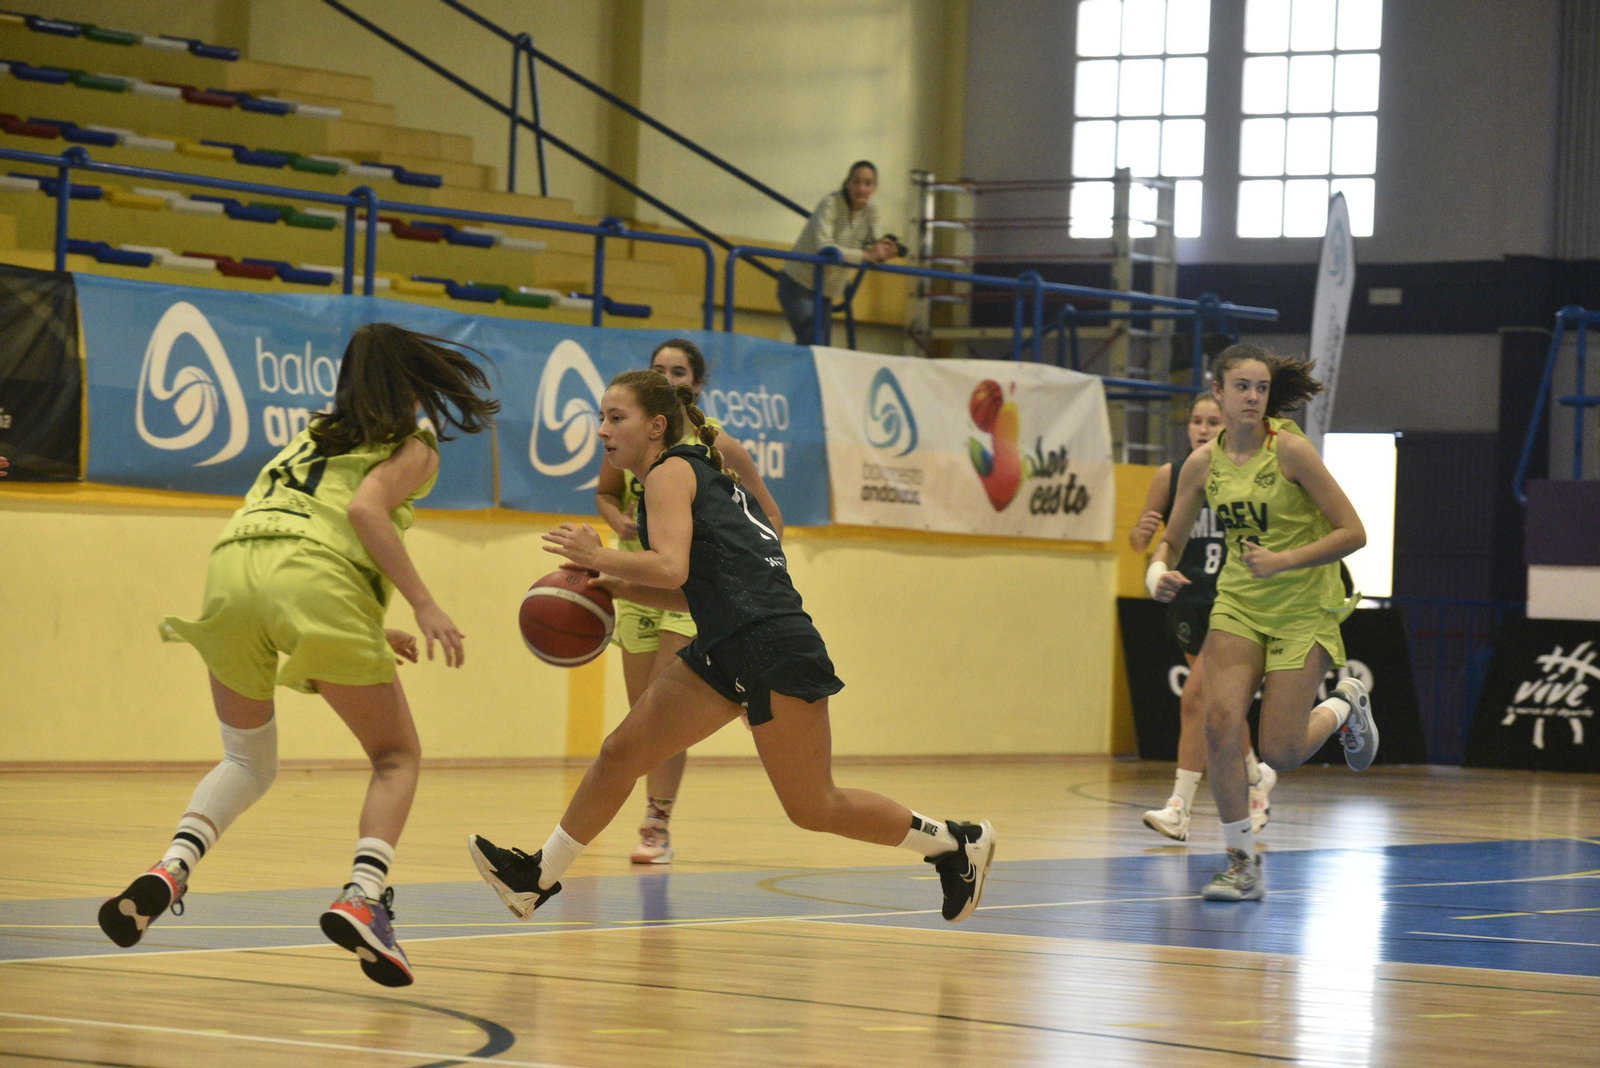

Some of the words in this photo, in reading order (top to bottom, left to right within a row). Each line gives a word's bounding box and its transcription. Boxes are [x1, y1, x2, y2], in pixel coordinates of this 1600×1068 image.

[256, 336, 340, 397] balo
[1029, 473, 1089, 516] cesto
[1204, 542, 1222, 575] 8
[922, 821, 939, 837] NIKE
